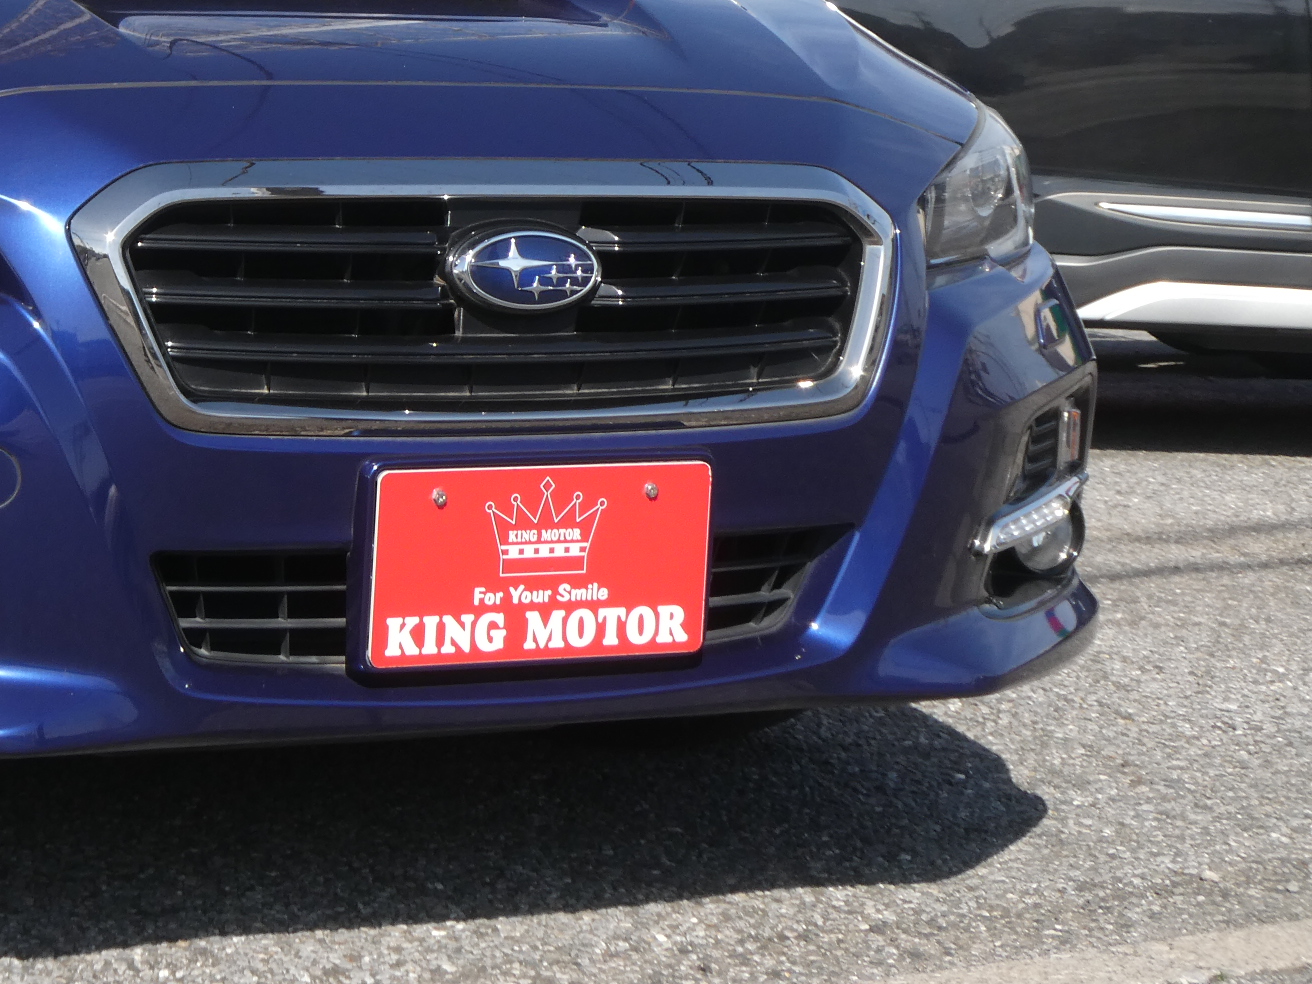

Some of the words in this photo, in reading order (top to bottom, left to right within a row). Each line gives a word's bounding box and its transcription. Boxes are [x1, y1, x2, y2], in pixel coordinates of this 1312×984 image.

[508, 529, 538, 543] KING
[540, 527, 582, 542] MOTOR
[473, 587, 504, 606] For
[509, 584, 551, 604] Your
[555, 582, 609, 602] Smile
[384, 612, 507, 657] KING
[523, 604, 689, 650] MOTOR
